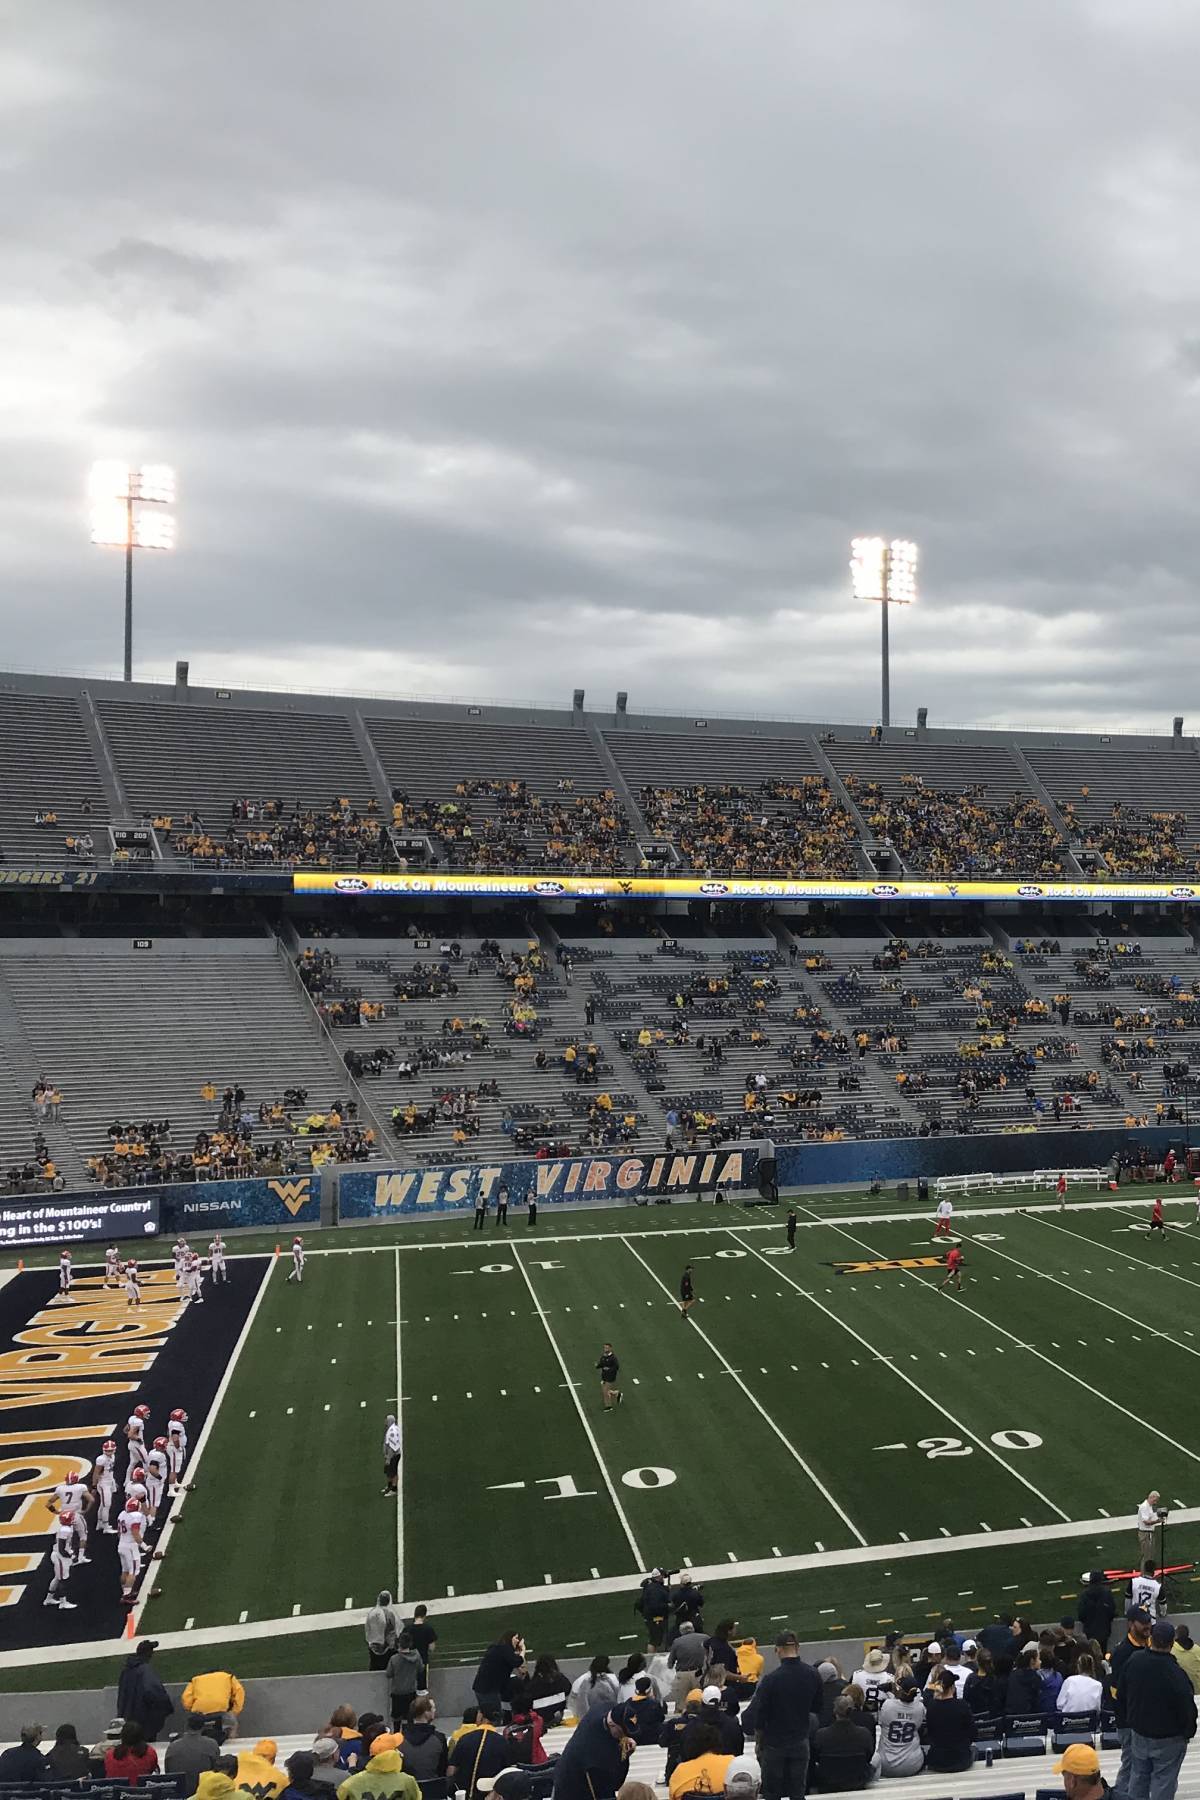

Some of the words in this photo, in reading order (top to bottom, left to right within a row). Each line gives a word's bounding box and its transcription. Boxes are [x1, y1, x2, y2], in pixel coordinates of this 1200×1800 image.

[74, 872, 98, 886] 21
[373, 880, 408, 891] Rock
[411, 880, 430, 891] On
[433, 881, 529, 893] Mountaineers
[731, 884, 763, 895] Rock
[766, 885, 783, 895] On
[785, 885, 868, 896] Mountaineers
[1046, 887, 1074, 898] Rock
[1075, 888, 1092, 898] On
[1094, 888, 1168, 899] Mountaineers
[136, 940, 149, 948] 109
[374, 1168, 501, 1206] WEST
[537, 1153, 743, 1195] VIRGINIA
[3, 1210, 31, 1221] Heart
[33, 1208, 45, 1219] of
[45, 1205, 108, 1218] Mountaineer
[110, 1200, 151, 1213] Country!
[183, 1200, 242, 1213] NISSAN
[19, 1224, 31, 1235] in
[33, 1222, 55, 1233] the
[58, 1219, 102, 1232] $100's!
[916, 1430, 1043, 1460] 20
[536, 1467, 677, 1499] 10
[888, 1721, 916, 1743] 68
